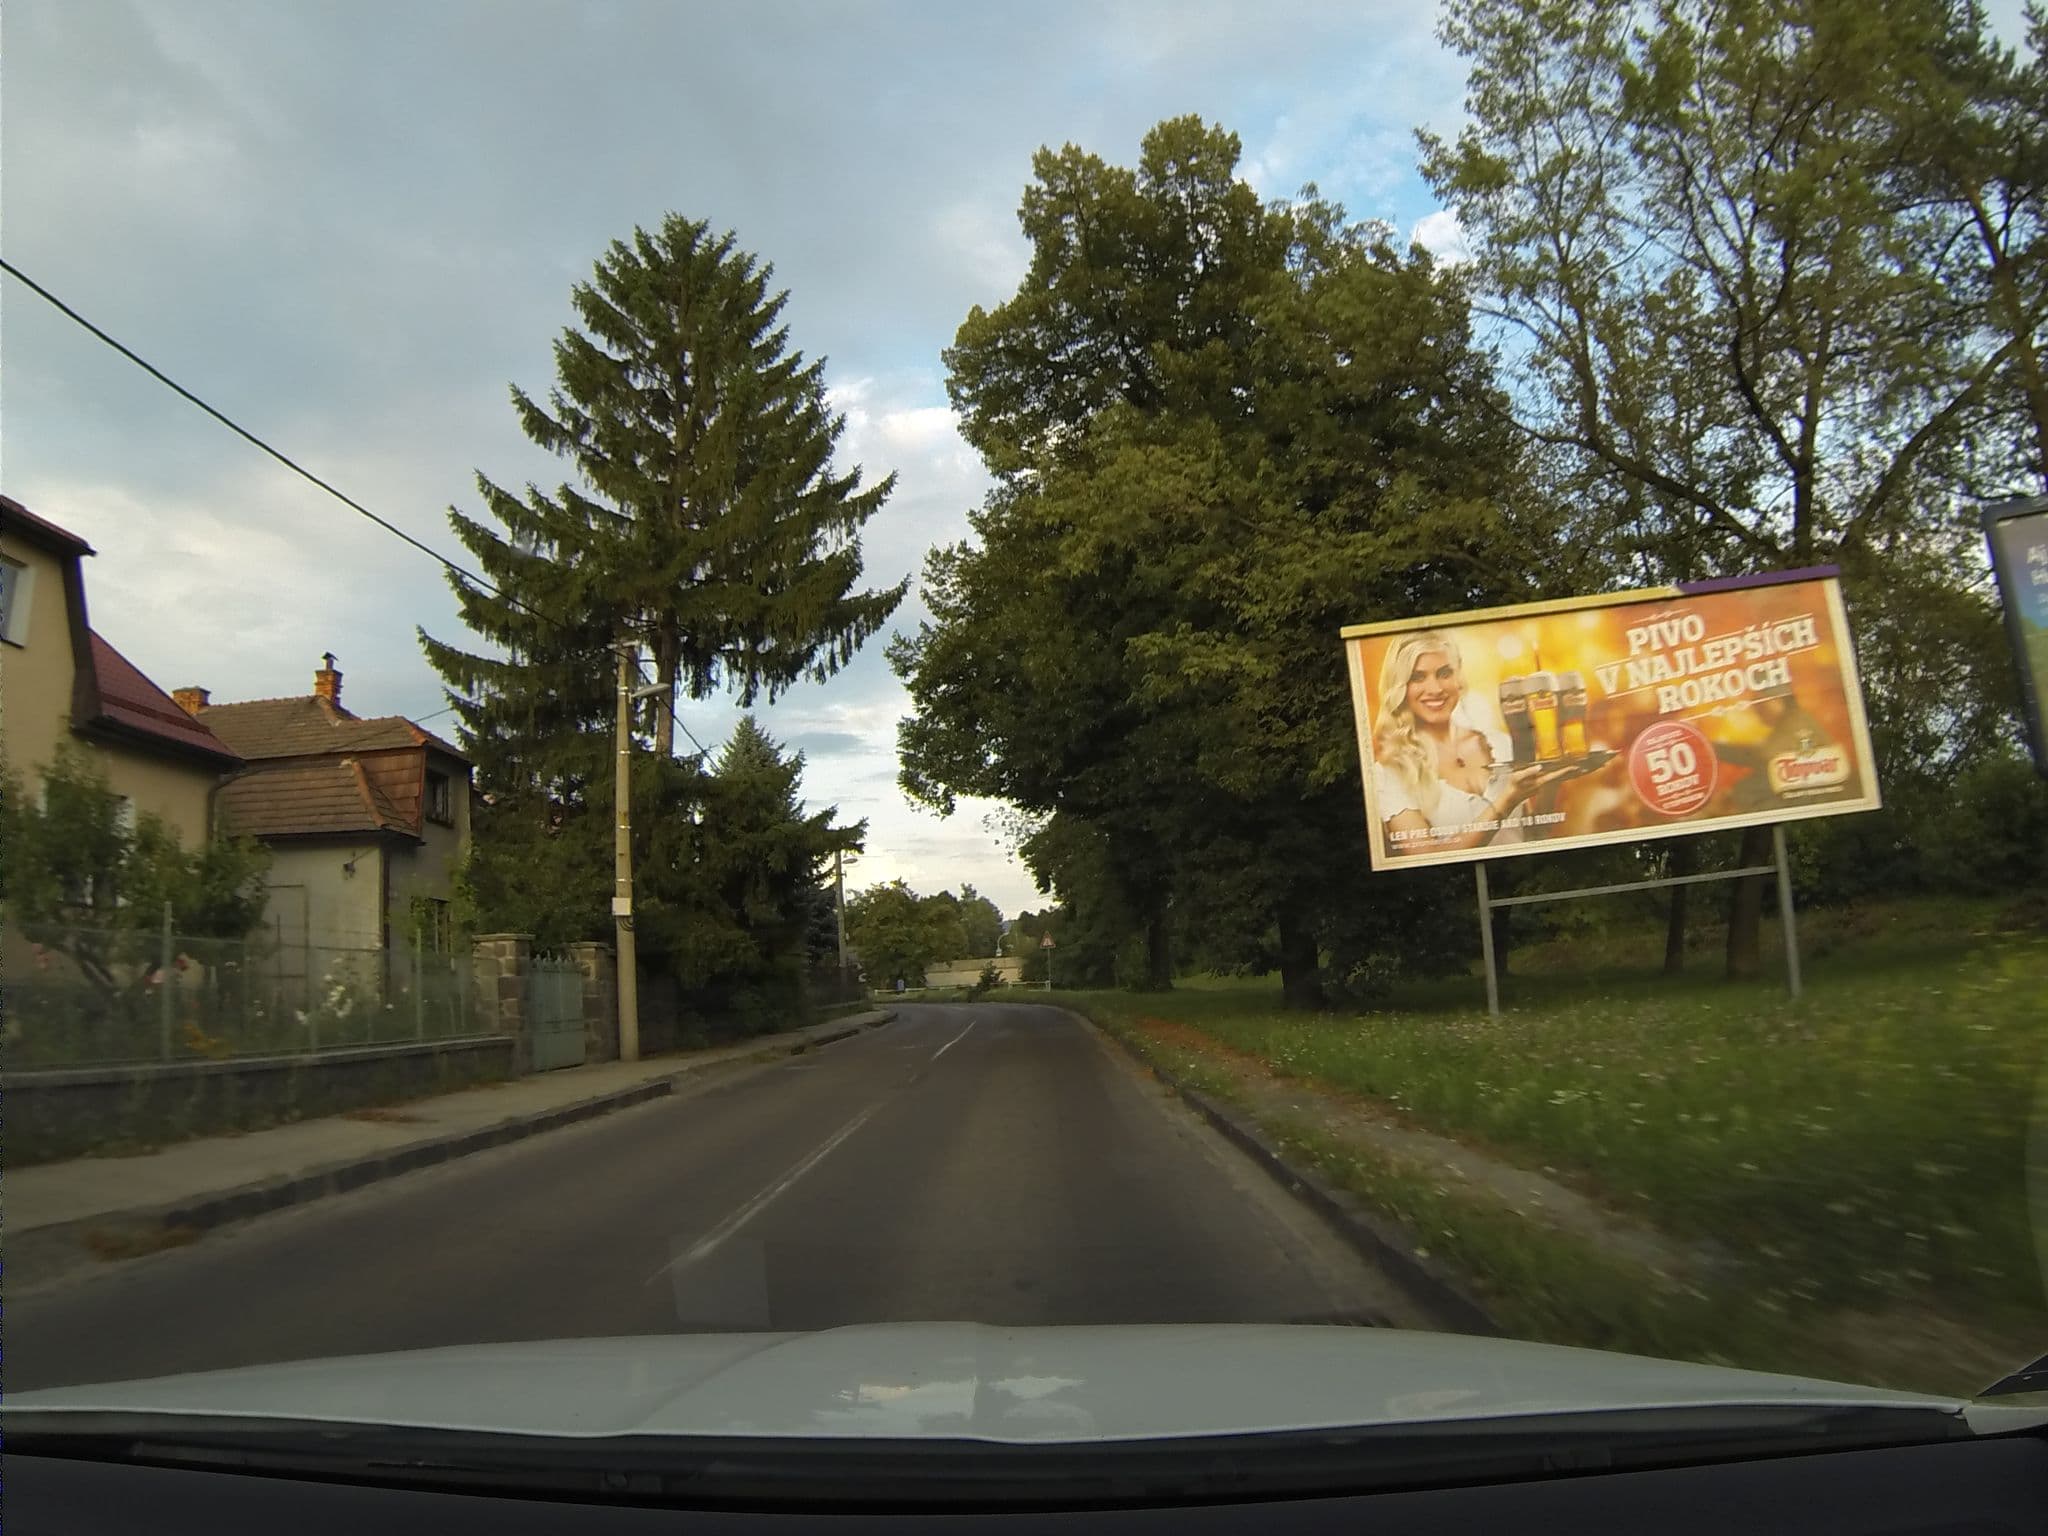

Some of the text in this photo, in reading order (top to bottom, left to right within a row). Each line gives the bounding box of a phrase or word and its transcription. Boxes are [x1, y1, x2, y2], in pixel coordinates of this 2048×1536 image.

[1595, 617, 1820, 695] V NAJLEPŠÍCH
[1626, 614, 1704, 655] PIVO
[1657, 656, 1793, 714] ROKOCH
[1646, 742, 1697, 784] 50
